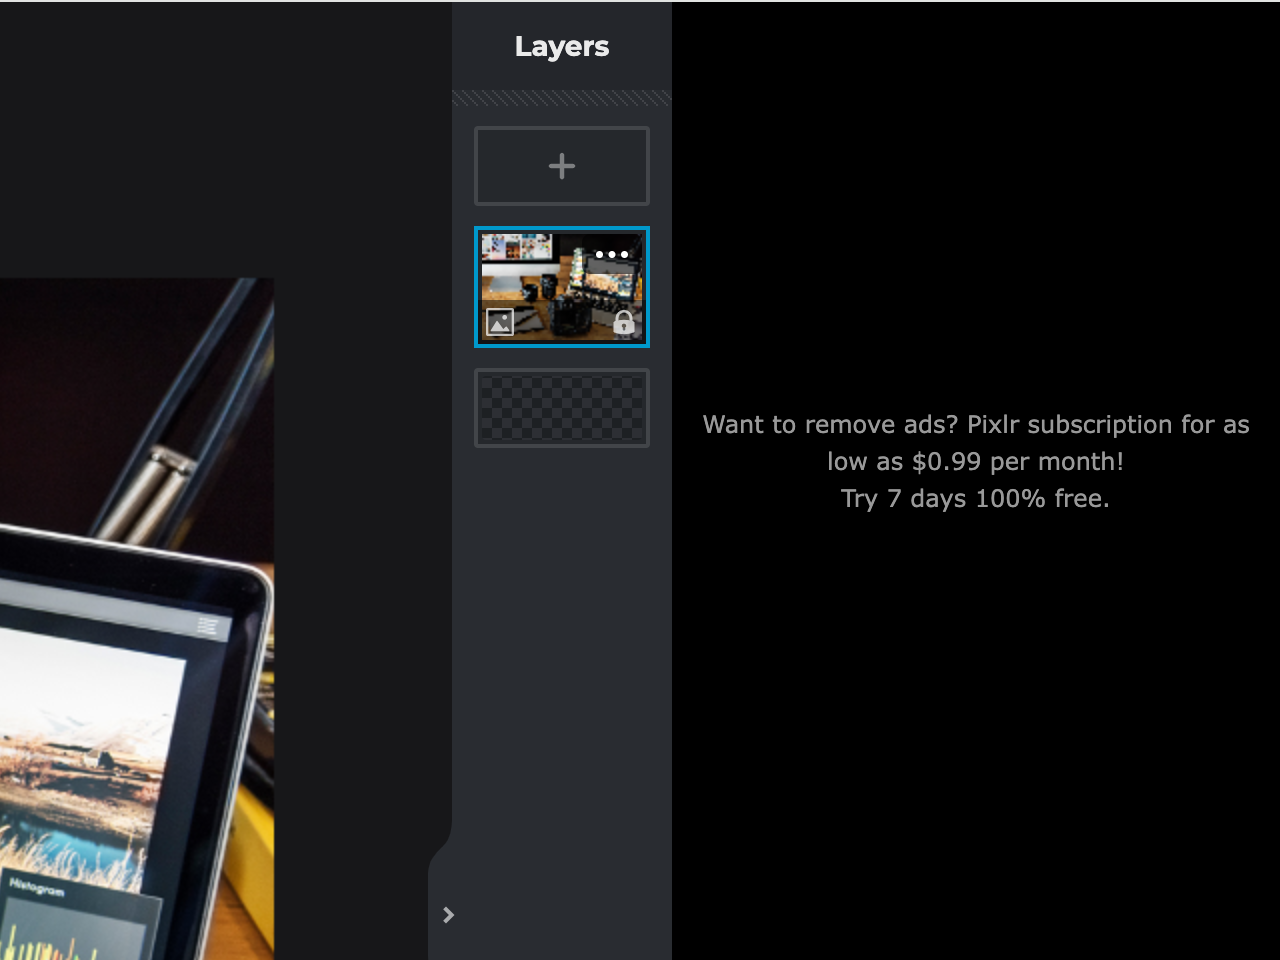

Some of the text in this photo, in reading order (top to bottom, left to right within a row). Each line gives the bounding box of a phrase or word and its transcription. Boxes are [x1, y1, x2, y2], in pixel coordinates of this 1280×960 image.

[516, 36, 609, 62] Layers
[703, 414, 1249, 438] Want to remove ads? Pixlr subscription for as
[829, 451, 1122, 475] low as $0.99 per month!
[841, 488, 1108, 512] Try 7 days 100% free.
[9, 876, 67, 898] Histogram
